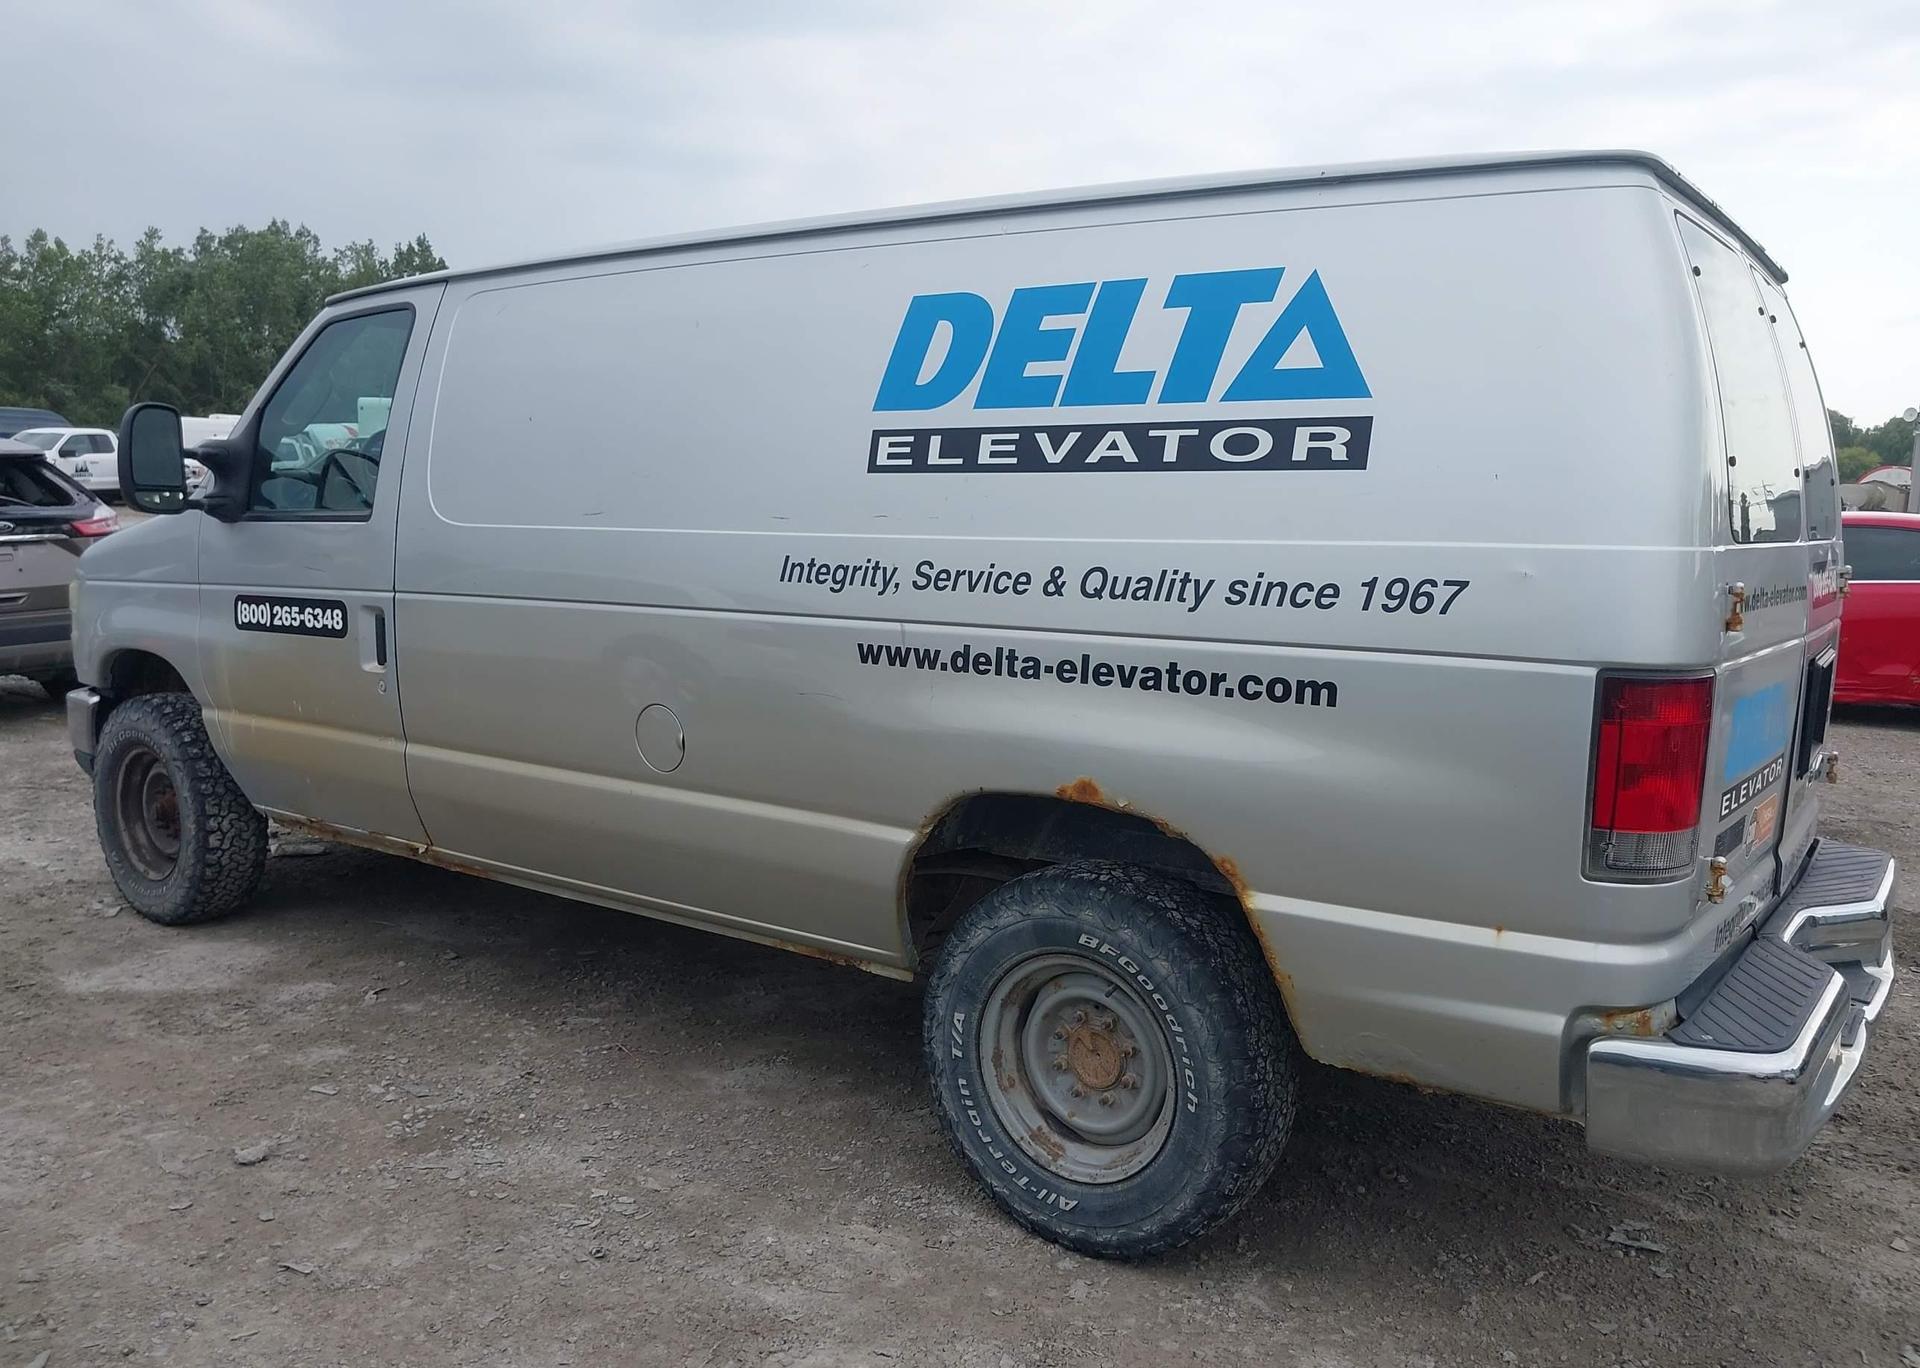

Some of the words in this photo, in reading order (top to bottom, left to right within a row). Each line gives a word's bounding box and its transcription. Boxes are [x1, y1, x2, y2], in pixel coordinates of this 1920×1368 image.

[872, 266, 1373, 413] DELTA
[876, 426, 1352, 466] ELEVATOR
[237, 600, 271, 627] (800)
[272, 605, 343, 630] 265-6348
[779, 554, 901, 596] Integrity,
[911, 560, 1032, 596] Service
[1042, 565, 1067, 597] &
[1079, 566, 1216, 613] Quality
[1224, 571, 1341, 610] since
[1360, 576, 1471, 615] 1967
[856, 642, 1338, 708] www.delta-elevator.com
[1721, 758, 1783, 816] ELEVATOR
[951, 1011, 966, 1060] T/A
[1077, 932, 1199, 1114] BFGoodrich
[957, 1077, 1079, 1212] All-Terrain
